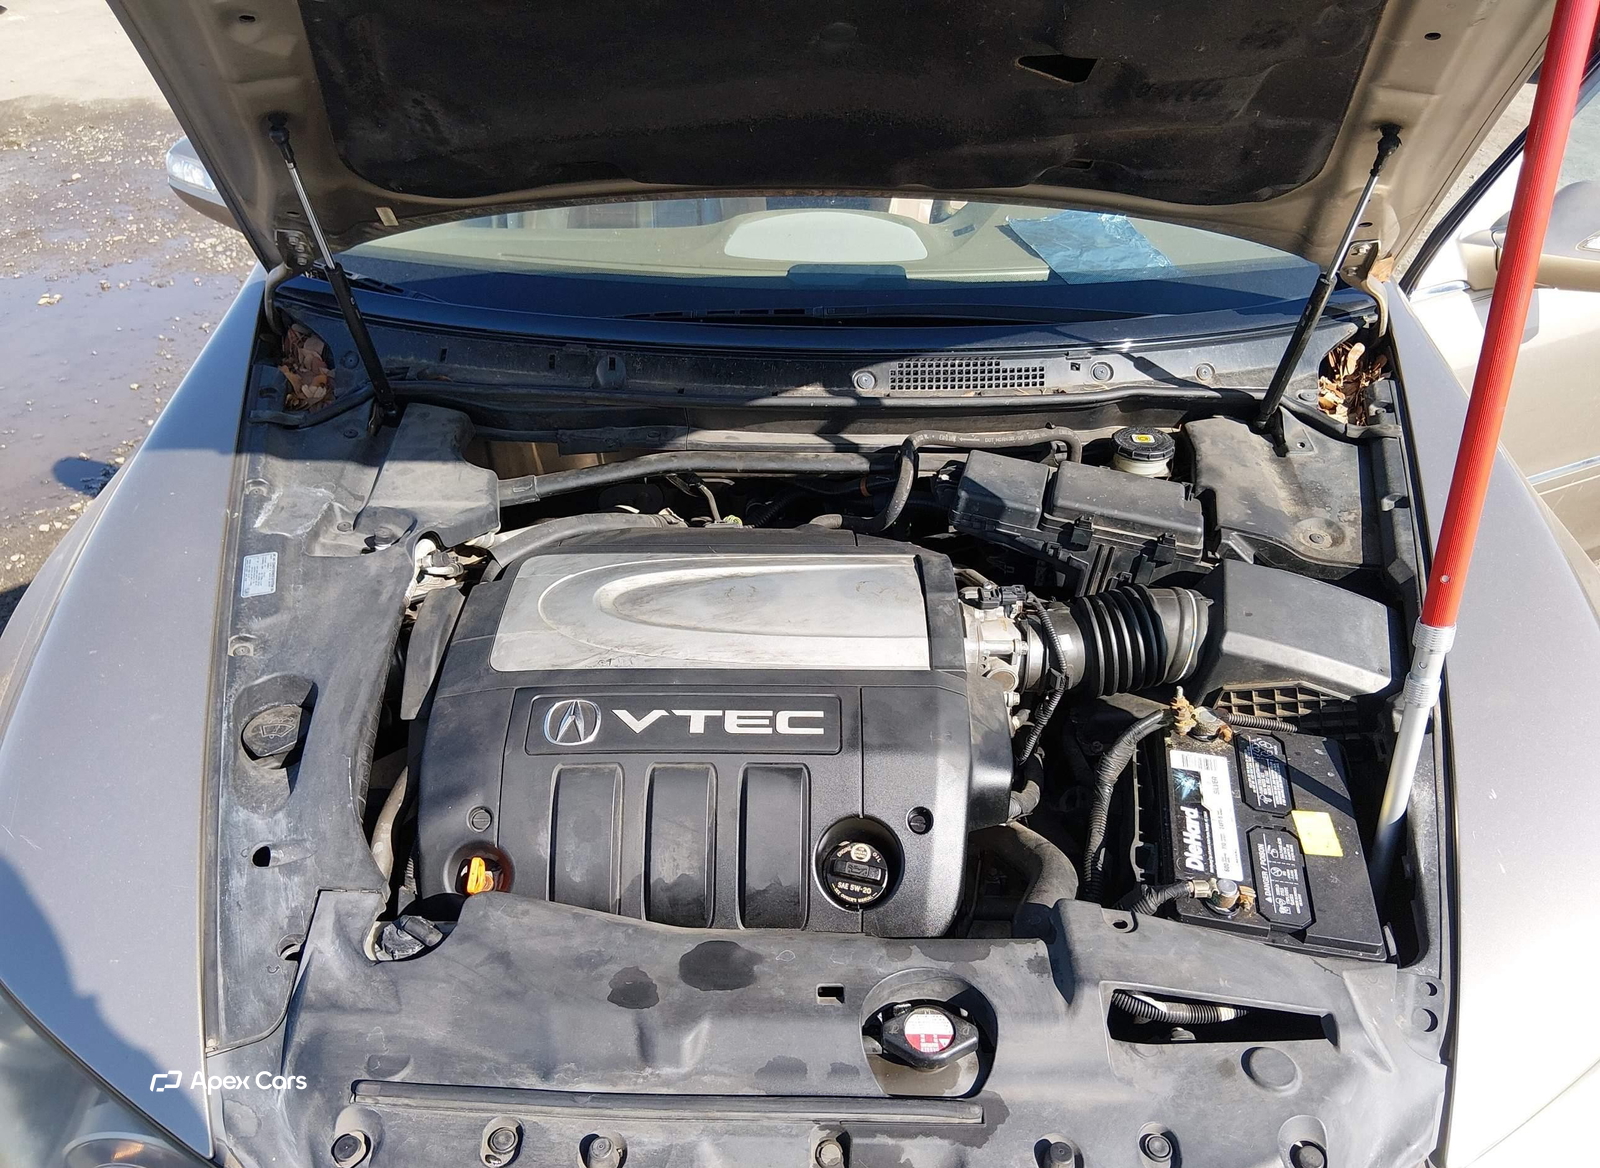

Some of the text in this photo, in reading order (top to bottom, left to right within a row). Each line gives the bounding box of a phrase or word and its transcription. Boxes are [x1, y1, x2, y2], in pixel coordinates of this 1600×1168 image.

[611, 709, 824, 734] VTEC
[1180, 805, 1204, 872] DieHard
[872, 852, 882, 863] OIL
[1257, 843, 1267, 866] POISON
[837, 882, 872, 894] SAE 5W-20
[1261, 870, 1272, 897] DANGER
